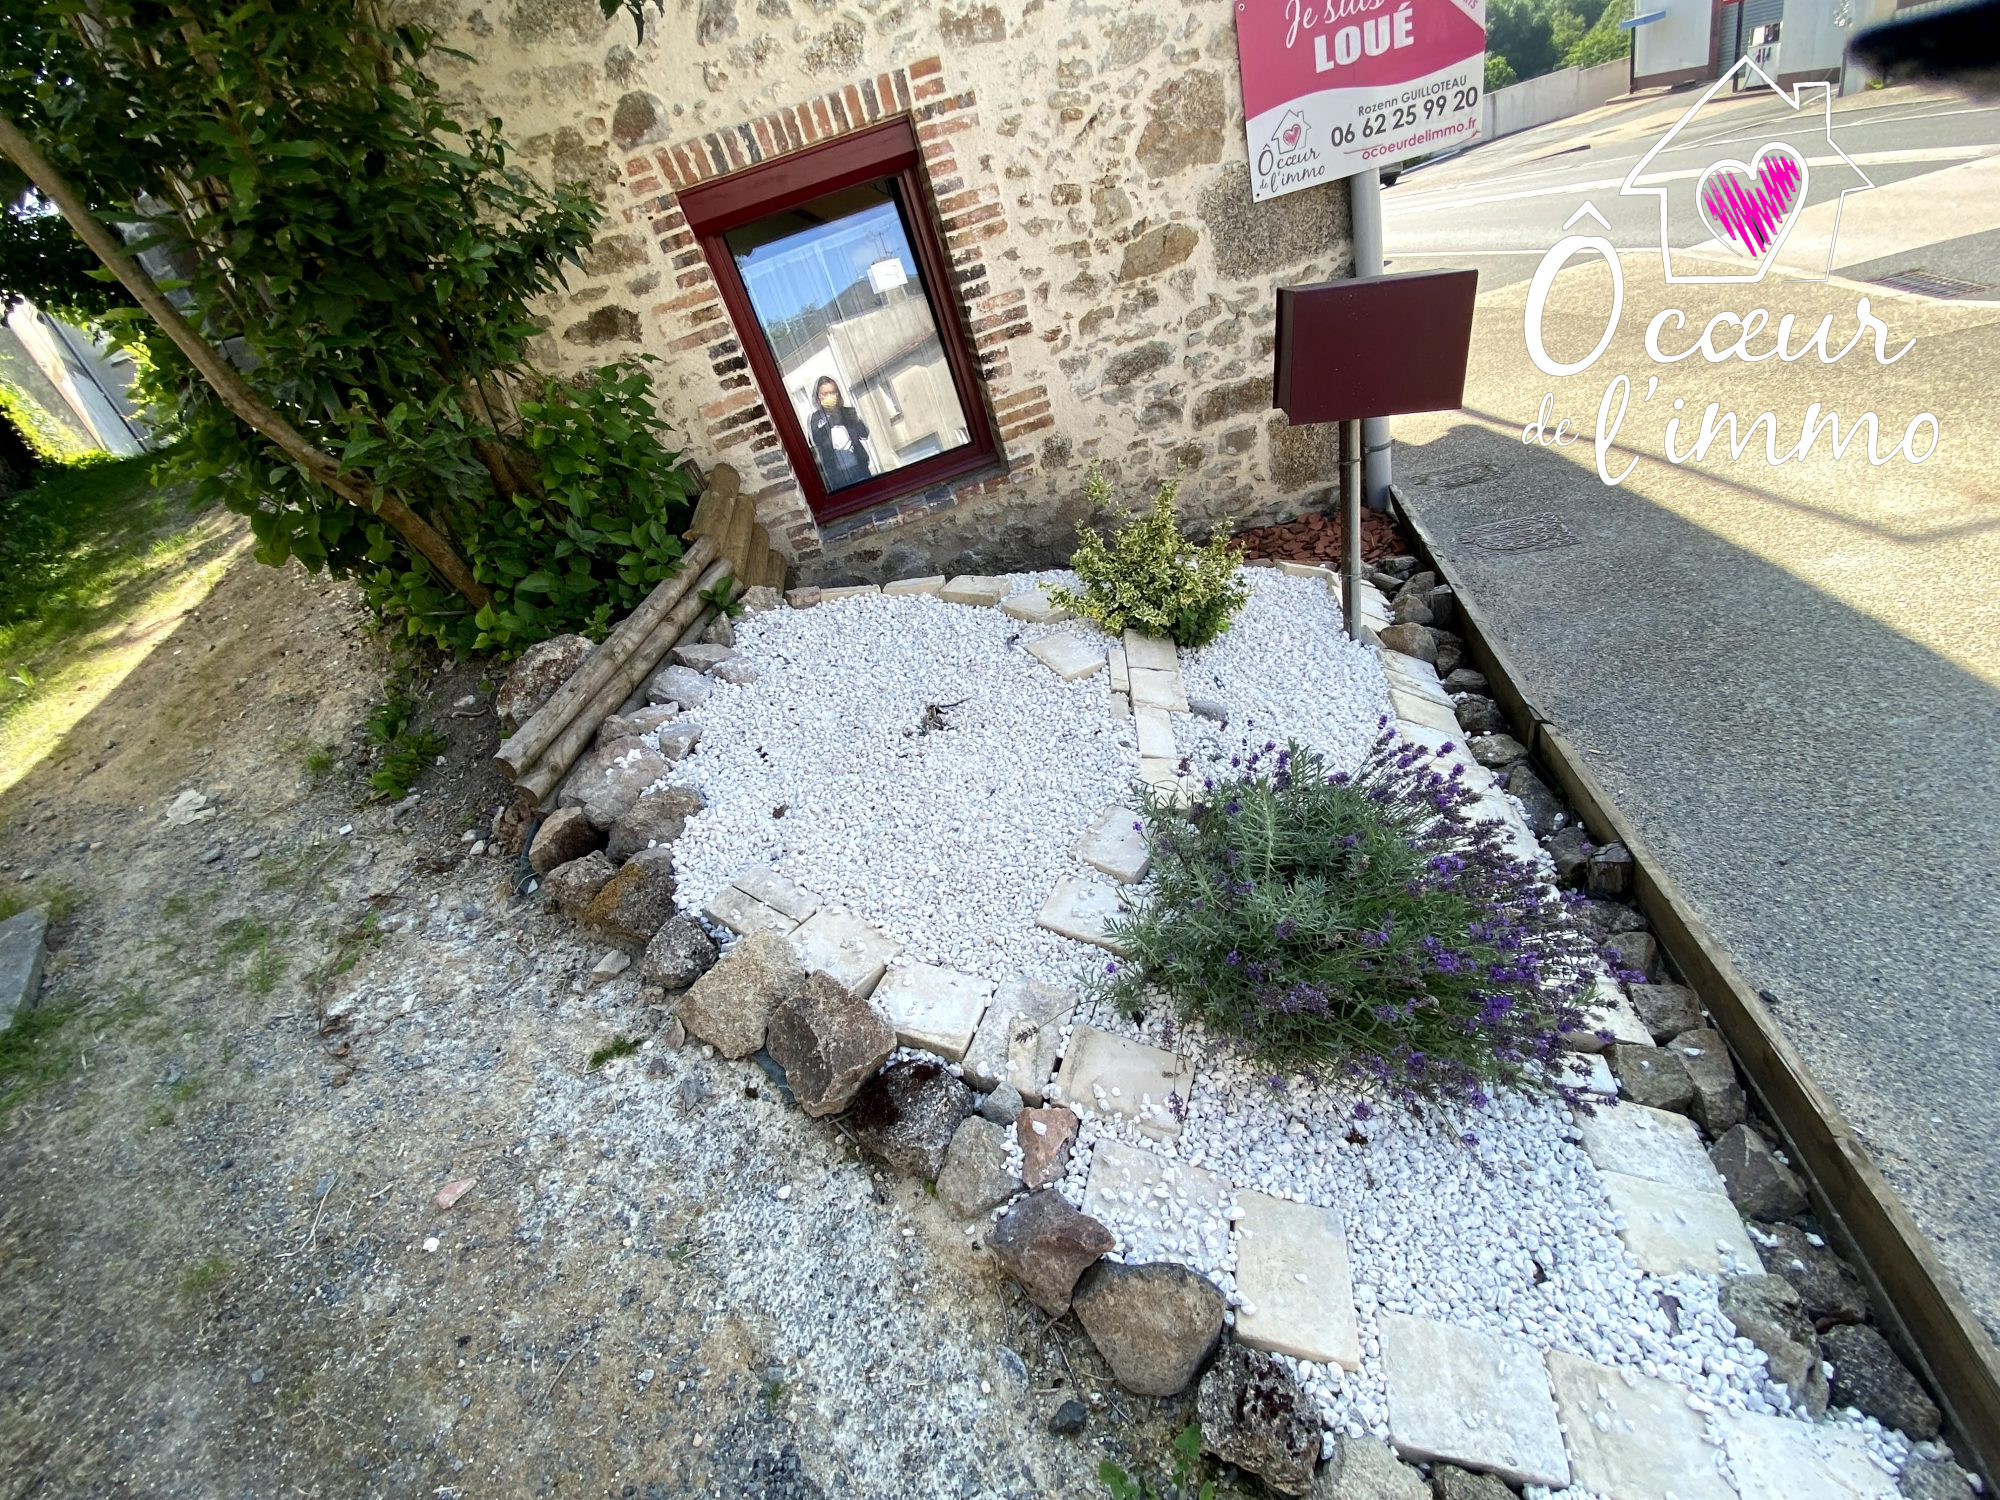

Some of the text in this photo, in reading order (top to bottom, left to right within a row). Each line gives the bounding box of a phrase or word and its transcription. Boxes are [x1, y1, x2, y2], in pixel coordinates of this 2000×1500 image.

[1285, 0, 1318, 48] Je
[1314, 1, 1415, 73] LOUÉ
[1331, 86, 1478, 147] 06 62 25 99 20
[1358, 75, 1467, 117] Rozenn GUILLOTEAU
[1258, 143, 1321, 176] Ô cœur
[1362, 116, 1477, 160] ocoeurdelimmo.fr
[1260, 165, 1325, 193] de l'immo
